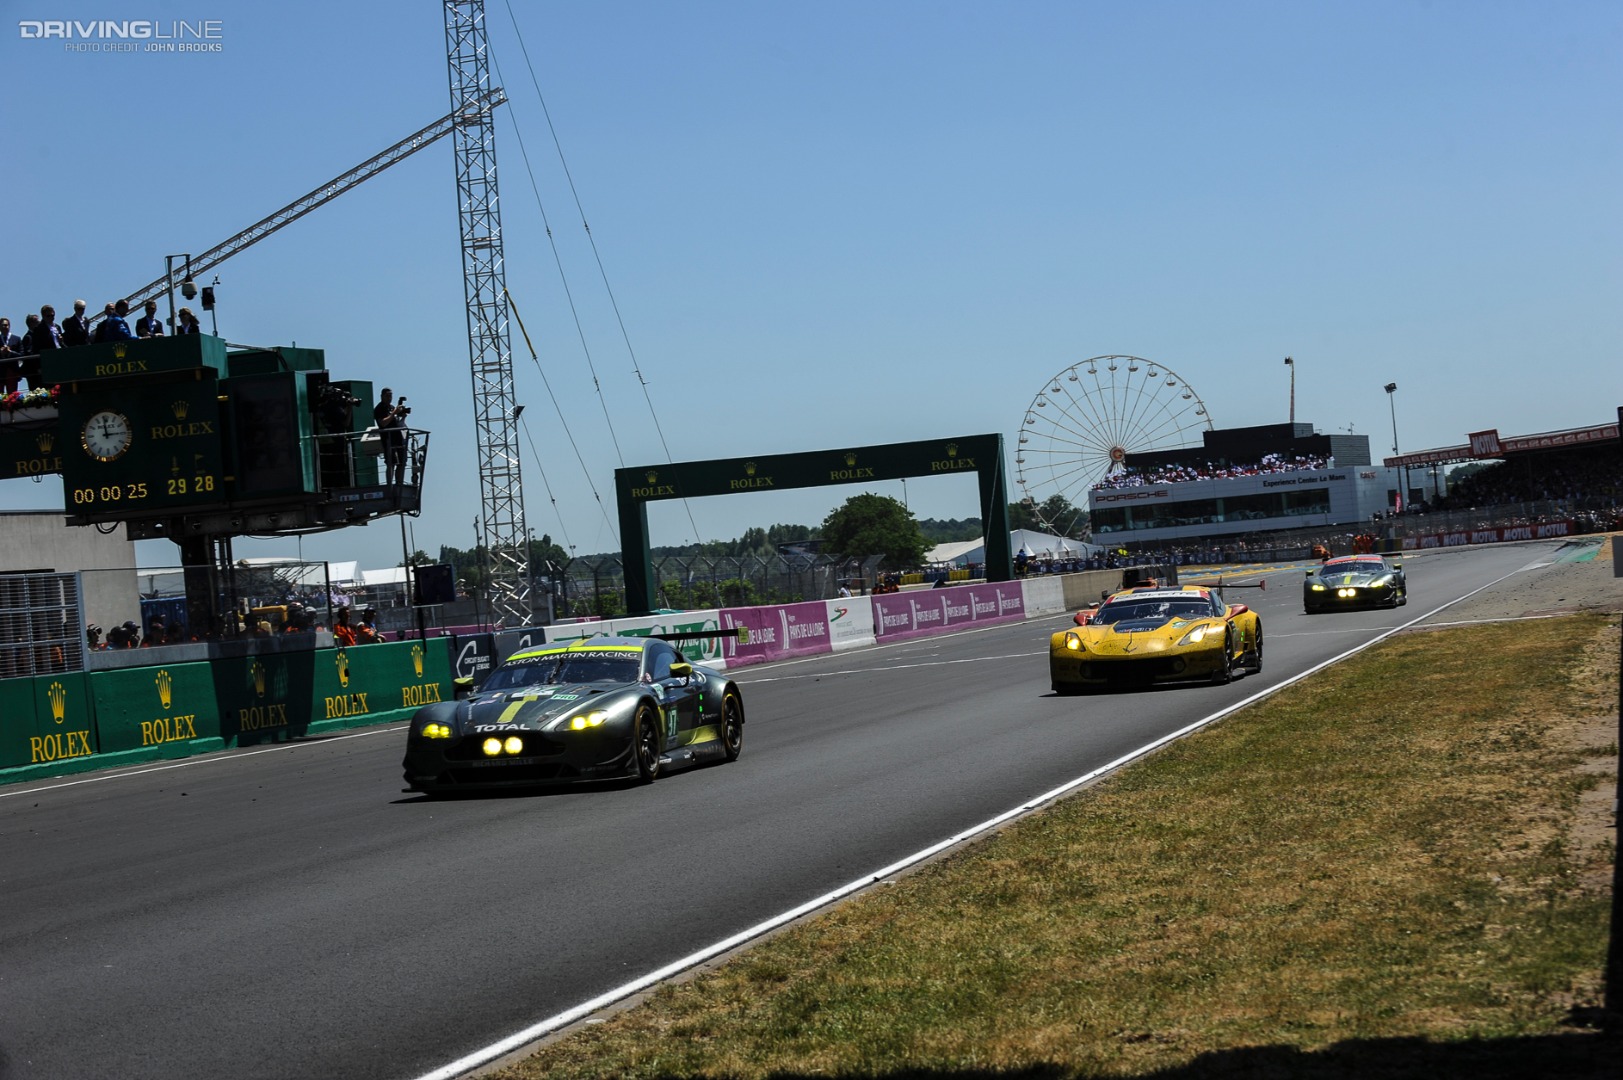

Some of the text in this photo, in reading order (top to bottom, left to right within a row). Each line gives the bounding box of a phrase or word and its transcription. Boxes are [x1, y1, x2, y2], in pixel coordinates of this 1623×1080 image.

[96, 360, 148, 376] ROLEX
[151, 421, 214, 440] ROLEX
[1471, 434, 1500, 456] MOTUL
[16, 456, 63, 475] ROLE
[931, 458, 976, 470] ROLEX
[830, 468, 874, 480] ROLEX
[168, 475, 214, 495] 29 28
[730, 476, 774, 489] ROLEX
[1263, 480, 1296, 488] Experience
[74, 483, 148, 504] 00 00 25
[632, 485, 675, 498] ROLEX
[1096, 490, 1168, 503] PORSCHE
[1472, 530, 1498, 543] MOTUL
[1504, 527, 1532, 540] MOTUL
[1537, 523, 1568, 538] MOTUL
[1443, 534, 1468, 546] MOTUL
[763, 628, 776, 643] LOIRE
[790, 624, 800, 640] PAYS
[800, 624, 807, 638] DE
[807, 622, 814, 637] LA
[814, 622, 825, 636] LOIRE
[502, 656, 541, 668] ASTON
[542, 652, 587, 662] MARTIN
[402, 682, 442, 708] ROLEX
[324, 692, 369, 720] ROLEX
[240, 703, 288, 732] ROLEX
[140, 714, 197, 746] ROLEX
[474, 723, 530, 732] TOTAL
[30, 730, 92, 763] ROLEX
